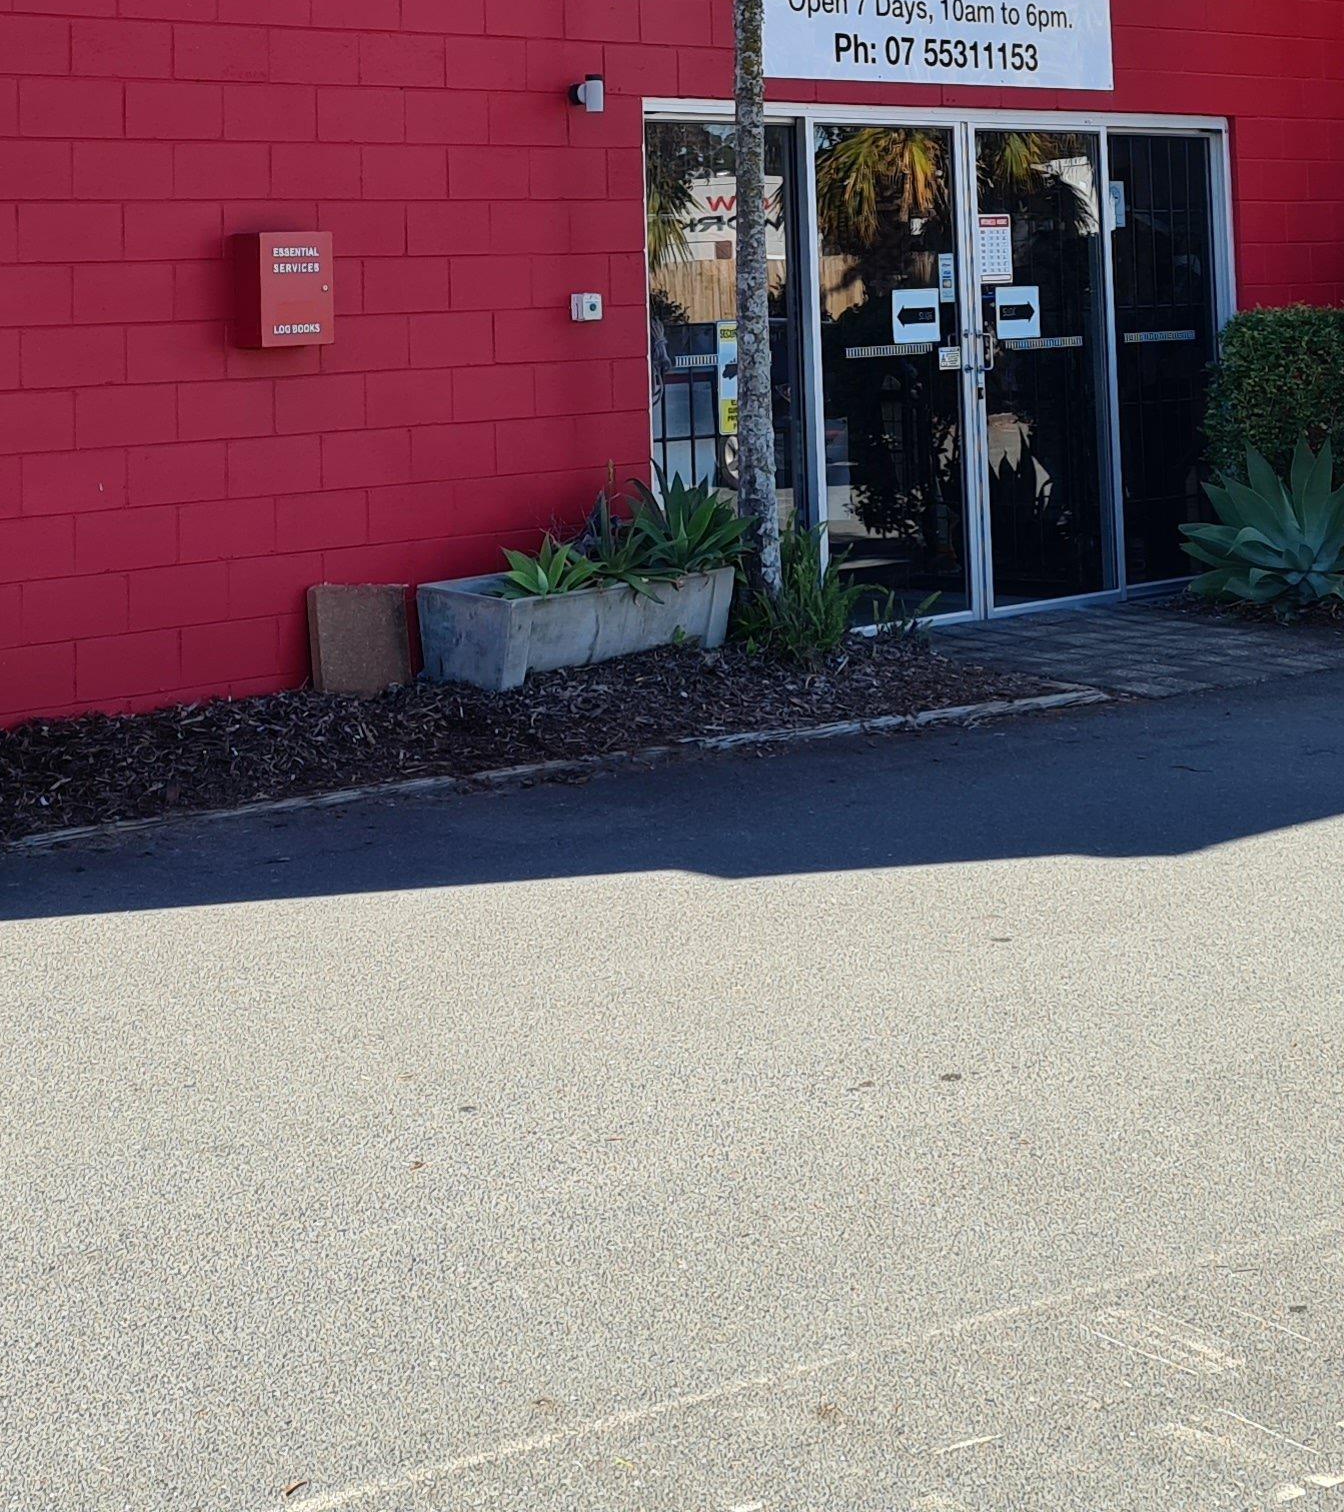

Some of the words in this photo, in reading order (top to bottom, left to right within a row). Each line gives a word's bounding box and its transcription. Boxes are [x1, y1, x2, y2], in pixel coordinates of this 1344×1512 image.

[1002, 3, 1020, 25] to
[1026, 5, 1073, 32] 6pm.
[834, 33, 877, 64] Ph:
[886, 36, 915, 65] 07
[924, 38, 1038, 71] 55311153
[272, 247, 320, 257] ESSENTIAL
[272, 263, 320, 273] SERVICES
[273, 324, 291, 334] LOG
[292, 323, 320, 334] BOOKS
